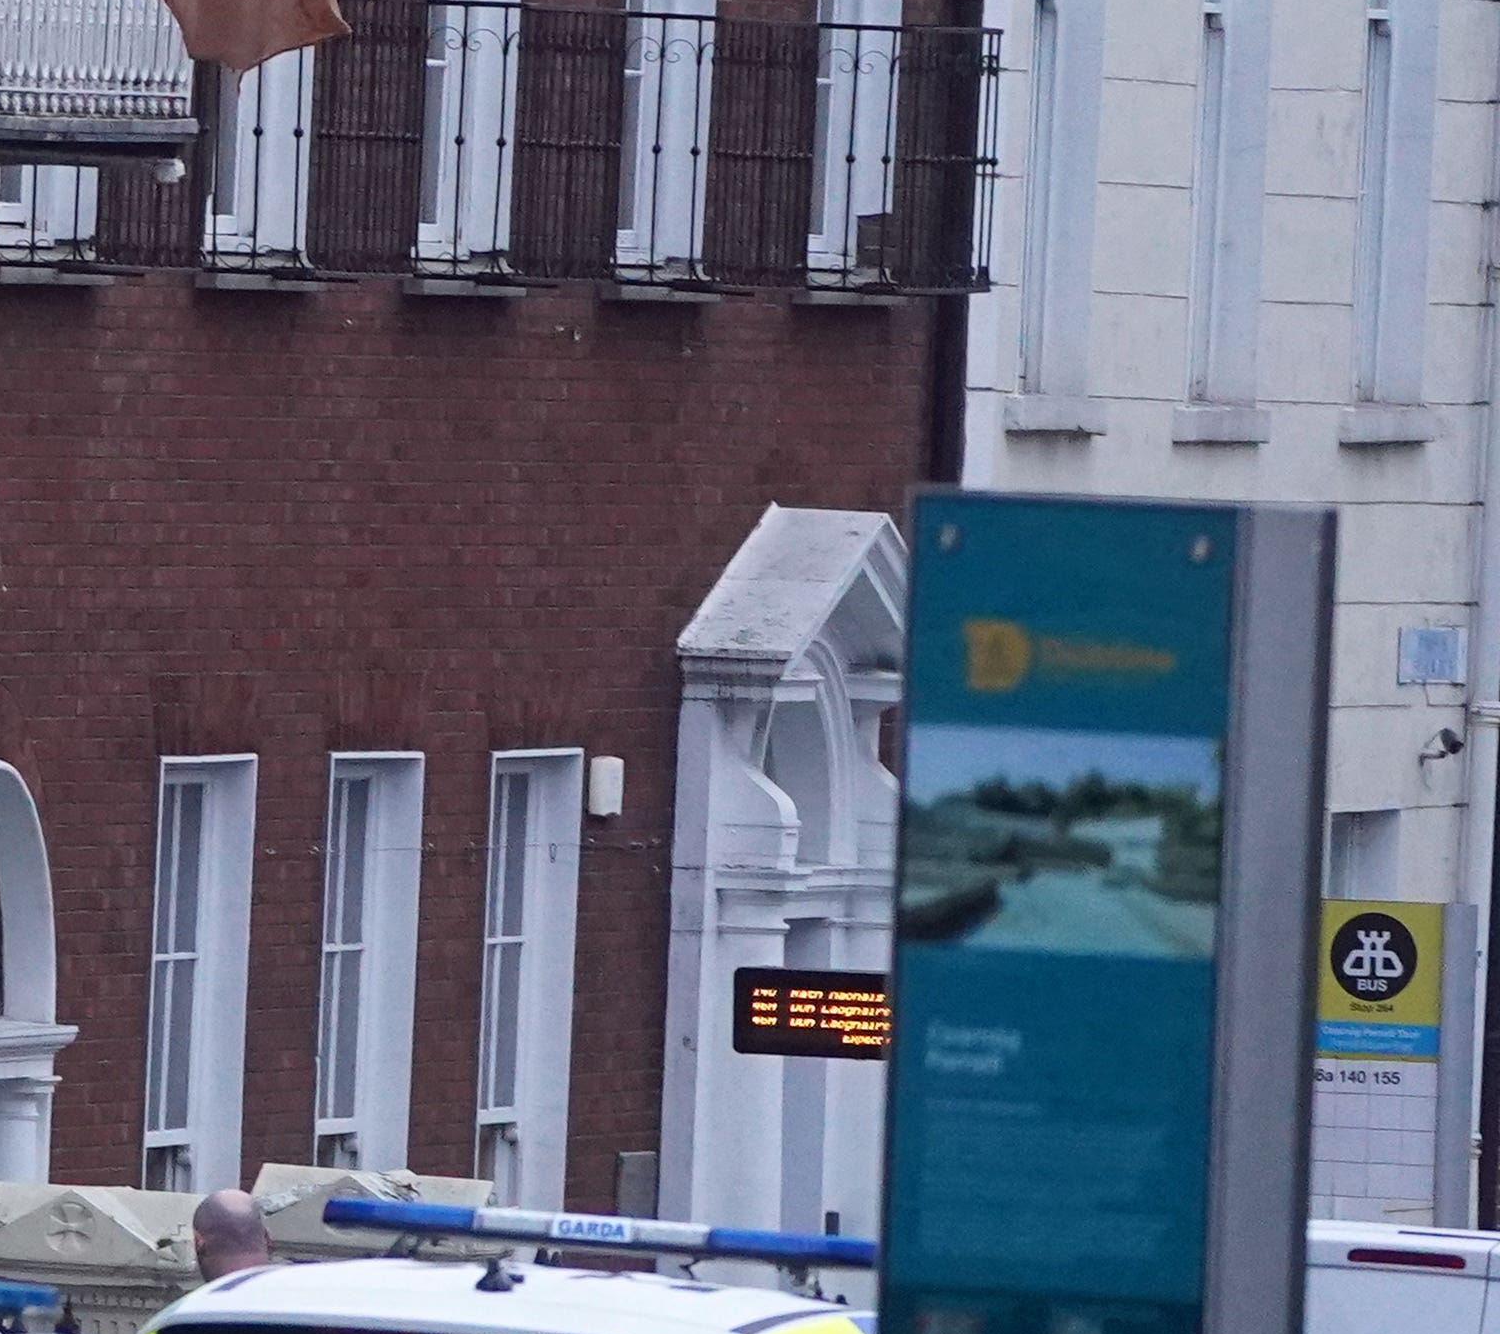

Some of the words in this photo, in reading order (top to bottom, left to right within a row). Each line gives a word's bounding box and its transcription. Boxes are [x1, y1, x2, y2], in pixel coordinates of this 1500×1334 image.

[1356, 977, 1389, 993] BUS
[1340, 1069, 1366, 1084] 140
[1373, 1070, 1401, 1085] 155
[559, 1219, 625, 1238] GARDA
